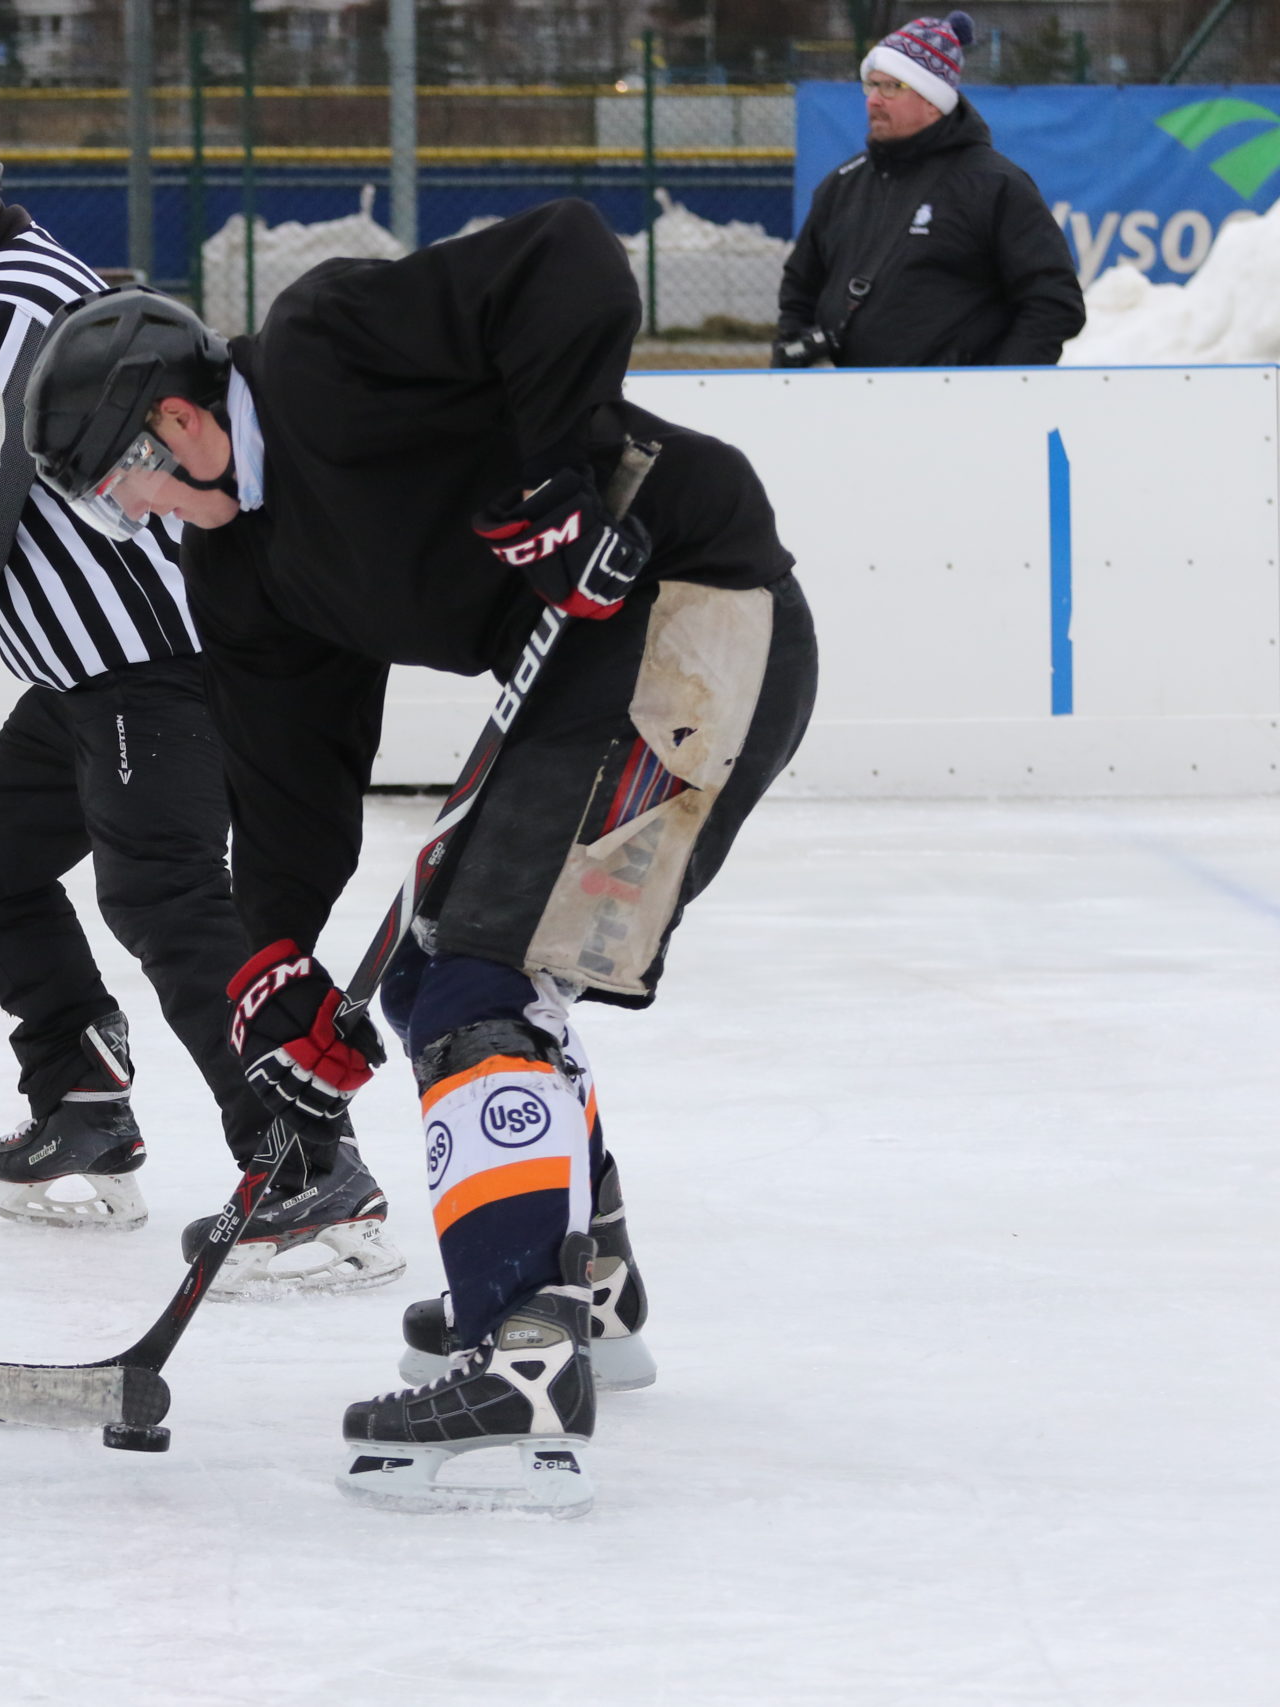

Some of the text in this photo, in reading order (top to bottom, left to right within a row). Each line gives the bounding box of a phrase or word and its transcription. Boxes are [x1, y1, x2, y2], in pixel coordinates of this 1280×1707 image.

[1052, 201, 1268, 292] yso
[492, 510, 581, 566] CM
[491, 605, 568, 734] BAU
[116, 714, 128, 769] EASTON
[231, 957, 310, 1055] CCM
[489, 1101, 541, 1133] USS
[427, 1132, 446, 1172] SS
[209, 1202, 236, 1243] 600
[221, 1215, 240, 1242] LITE
[508, 1330, 539, 1340] CCM
[533, 1461, 571, 1470] CCM
